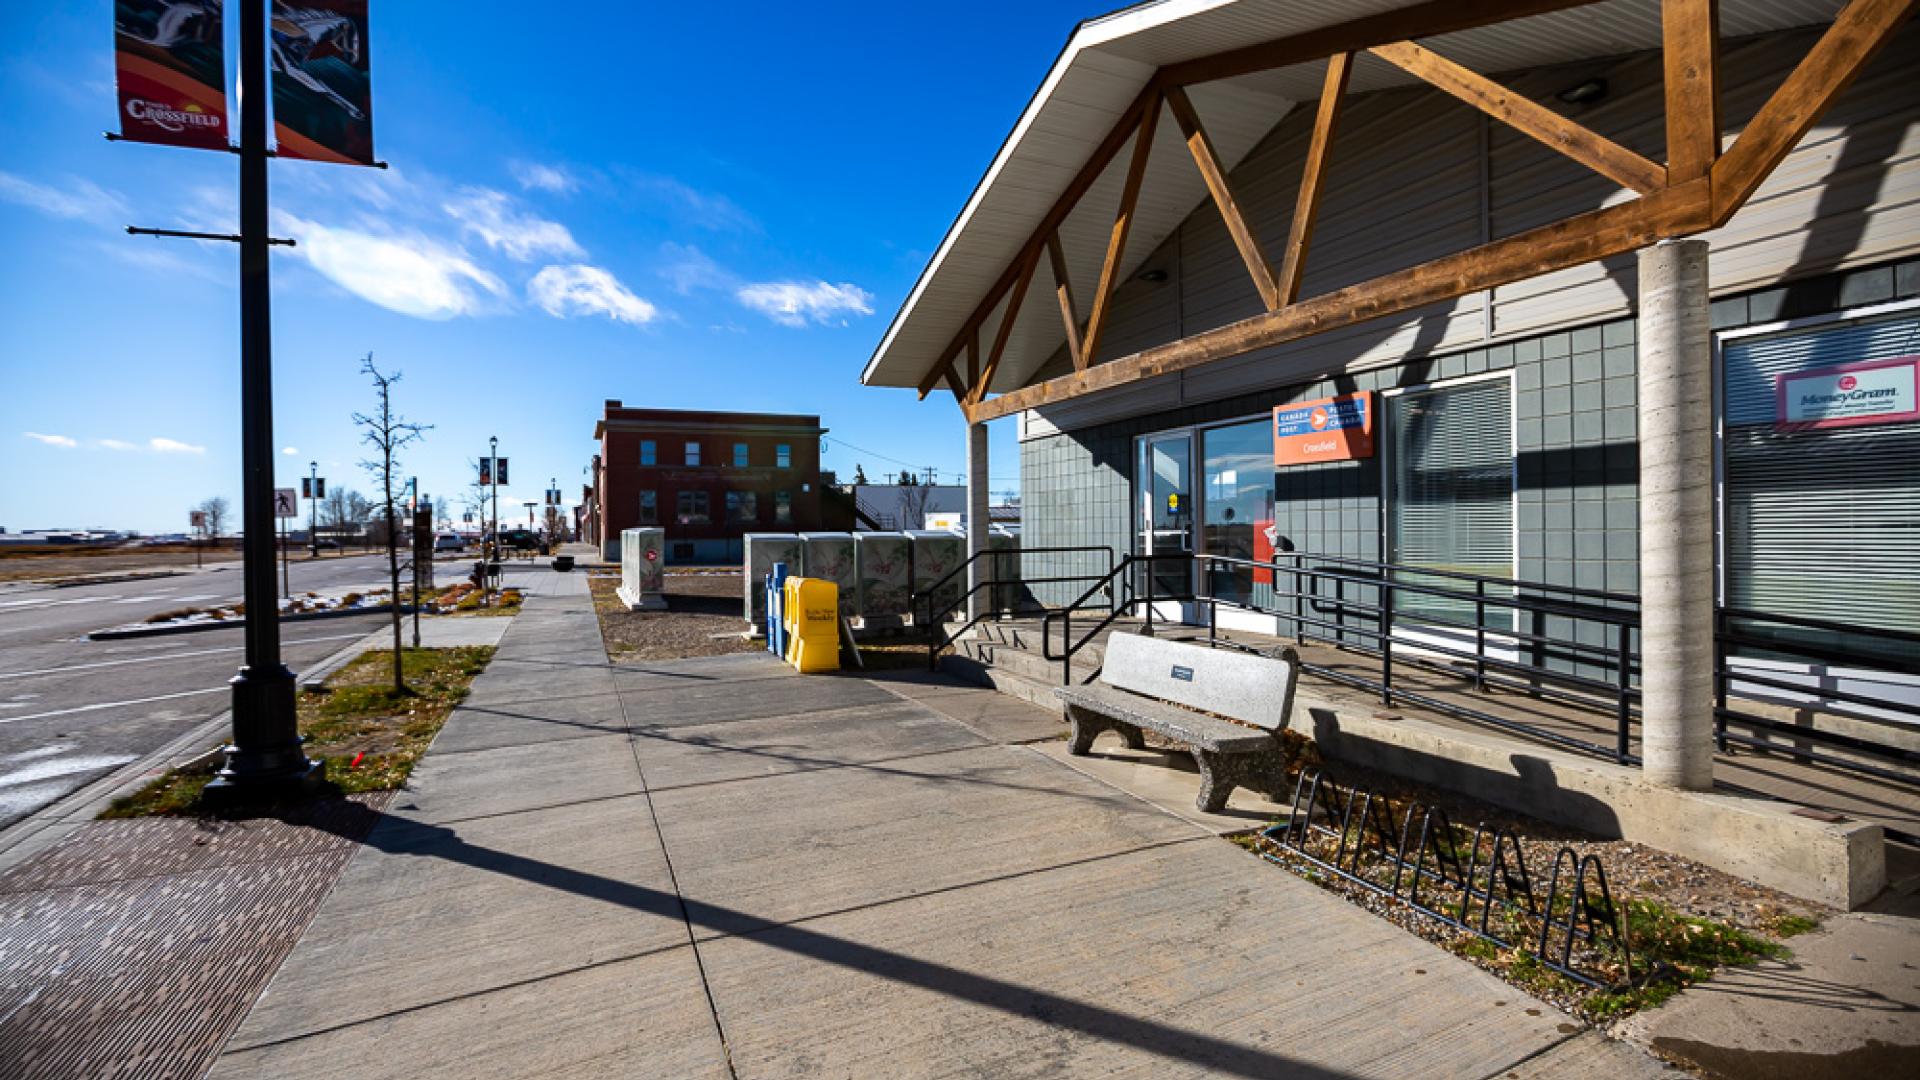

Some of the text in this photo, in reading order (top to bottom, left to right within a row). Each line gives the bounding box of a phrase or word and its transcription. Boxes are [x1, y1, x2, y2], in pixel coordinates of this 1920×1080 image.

[1280, 411, 1308, 421] CANADA
[1280, 425, 1298, 433] POST
[1303, 440, 1337, 453] Crossfield
